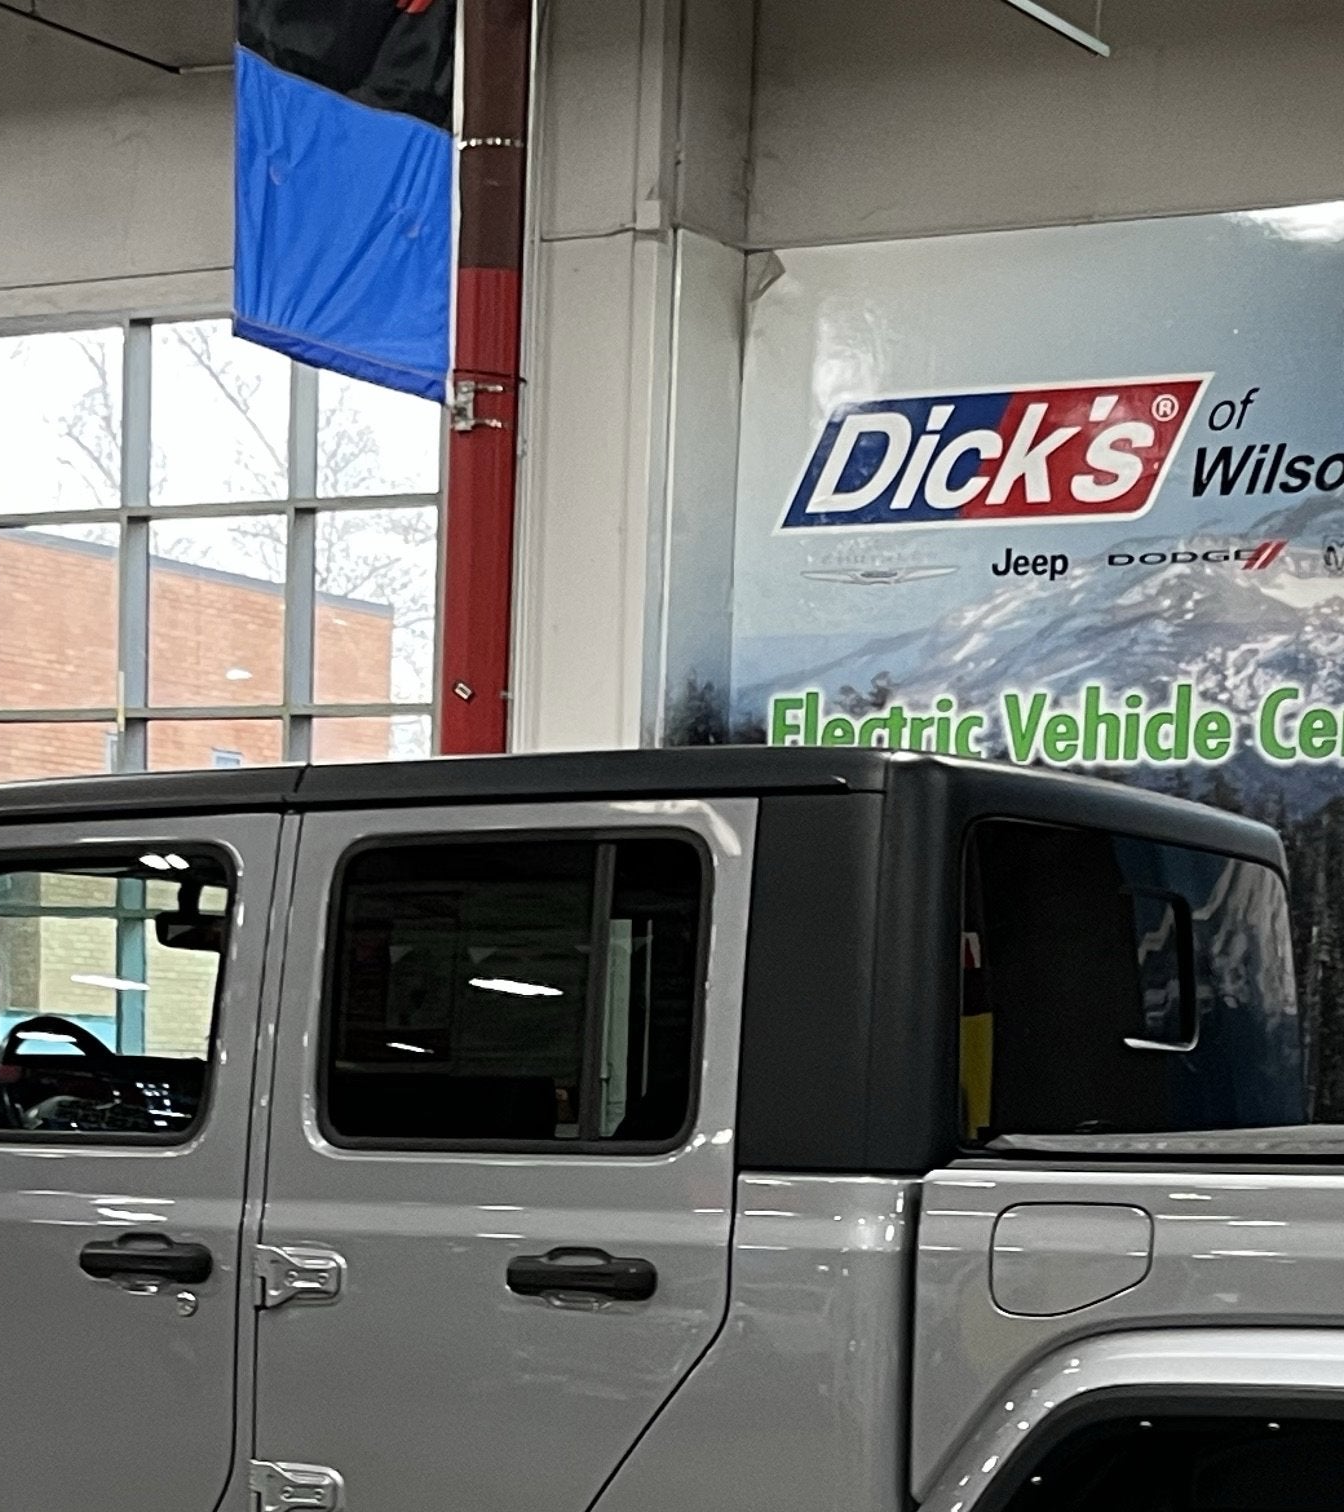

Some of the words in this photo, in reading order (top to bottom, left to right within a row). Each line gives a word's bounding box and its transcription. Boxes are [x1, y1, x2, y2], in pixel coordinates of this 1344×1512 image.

[1208, 387, 1260, 431] of
[805, 395, 1155, 514] Dick's
[992, 547, 1069, 581] Jeep
[1108, 549, 1259, 566] DODGE
[771, 692, 984, 758] Electric
[1003, 684, 1232, 762] Vehicle
